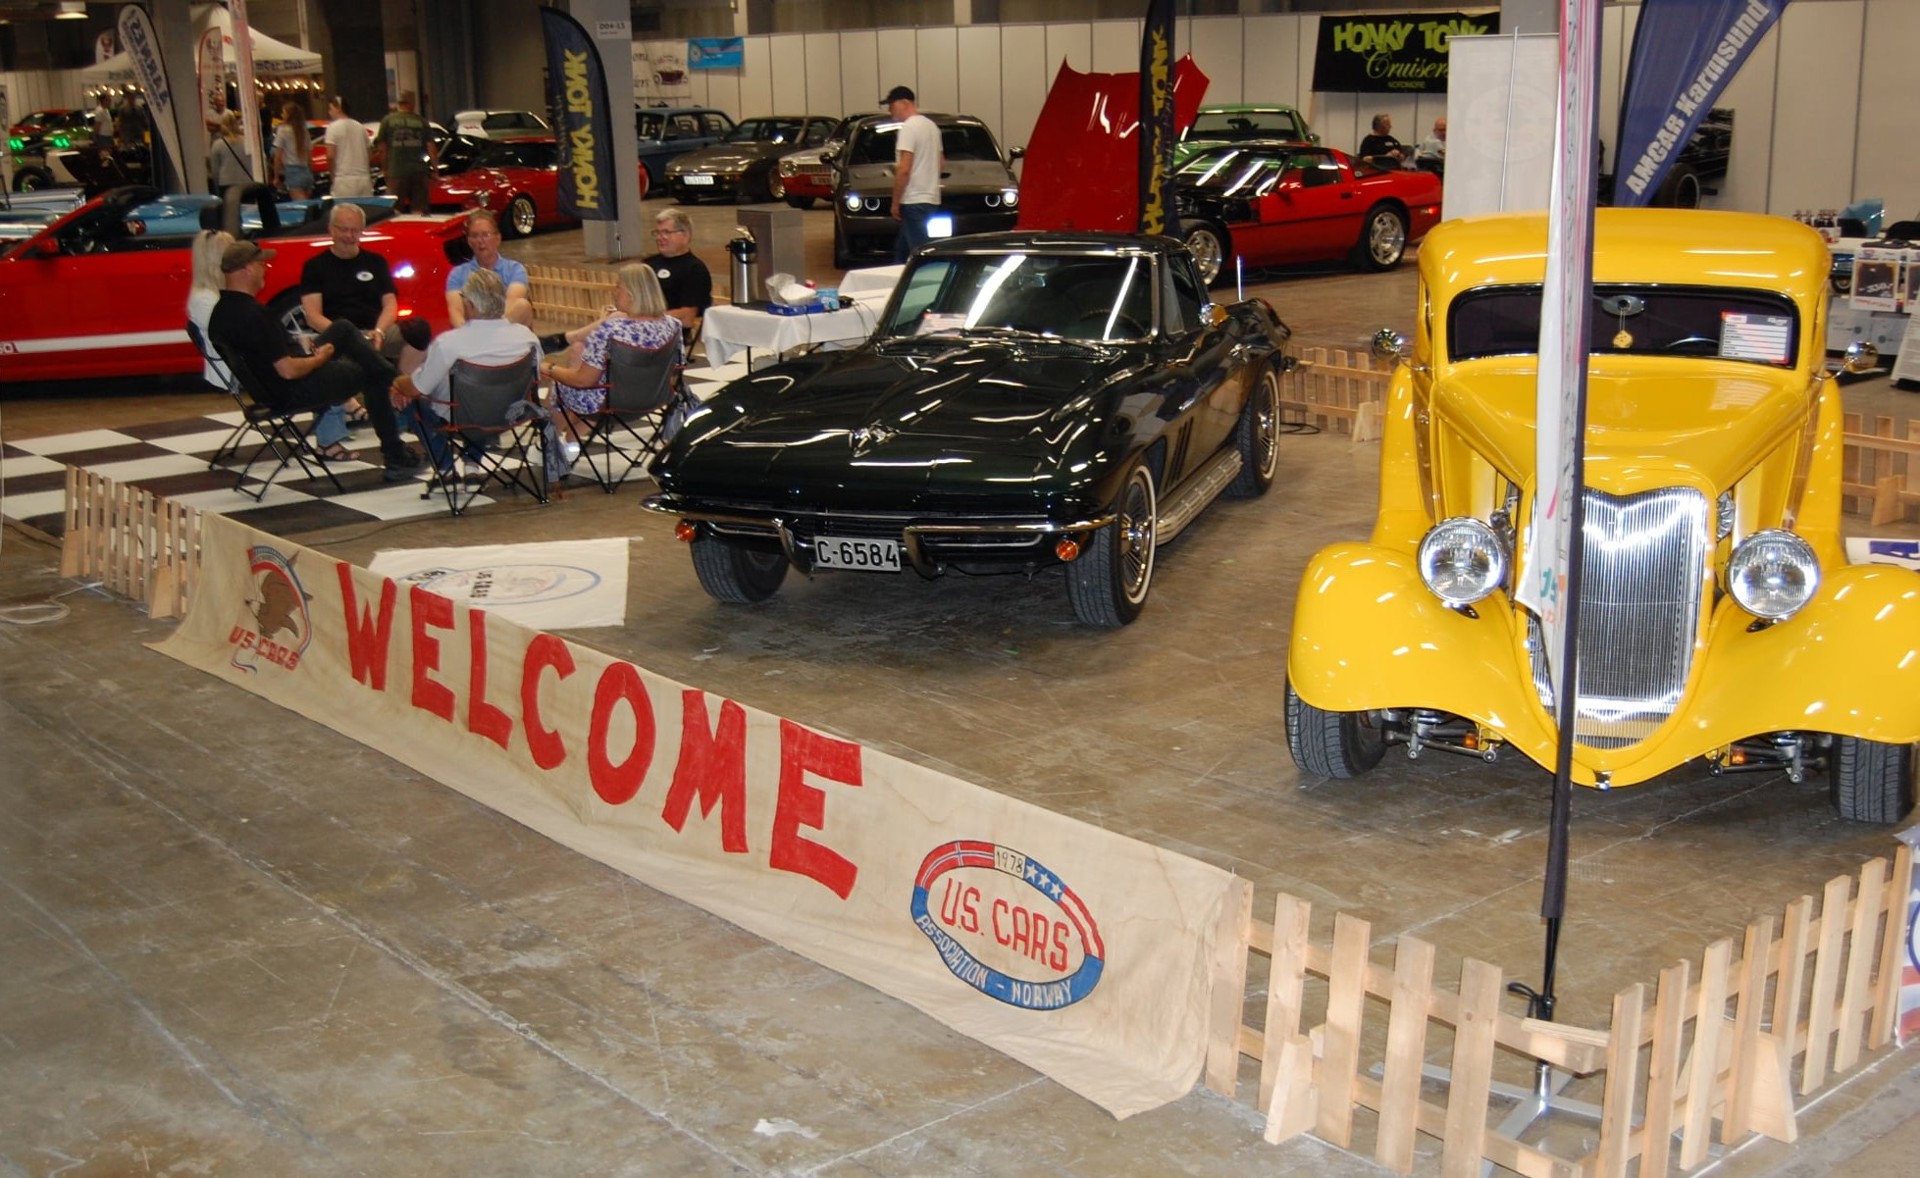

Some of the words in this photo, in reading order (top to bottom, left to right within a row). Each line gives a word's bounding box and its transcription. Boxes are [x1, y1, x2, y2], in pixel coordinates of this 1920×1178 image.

[1333, 20, 1414, 53] HONKY
[816, 540, 898, 568] C-6584
[255, 638, 300, 671] CARS
[336, 562, 863, 900] WELCOME
[996, 851, 1024, 874] 1978
[992, 898, 1070, 972] CARS
[916, 914, 988, 989] ASSOCIATION
[1011, 979, 1073, 1008] NORWAY
